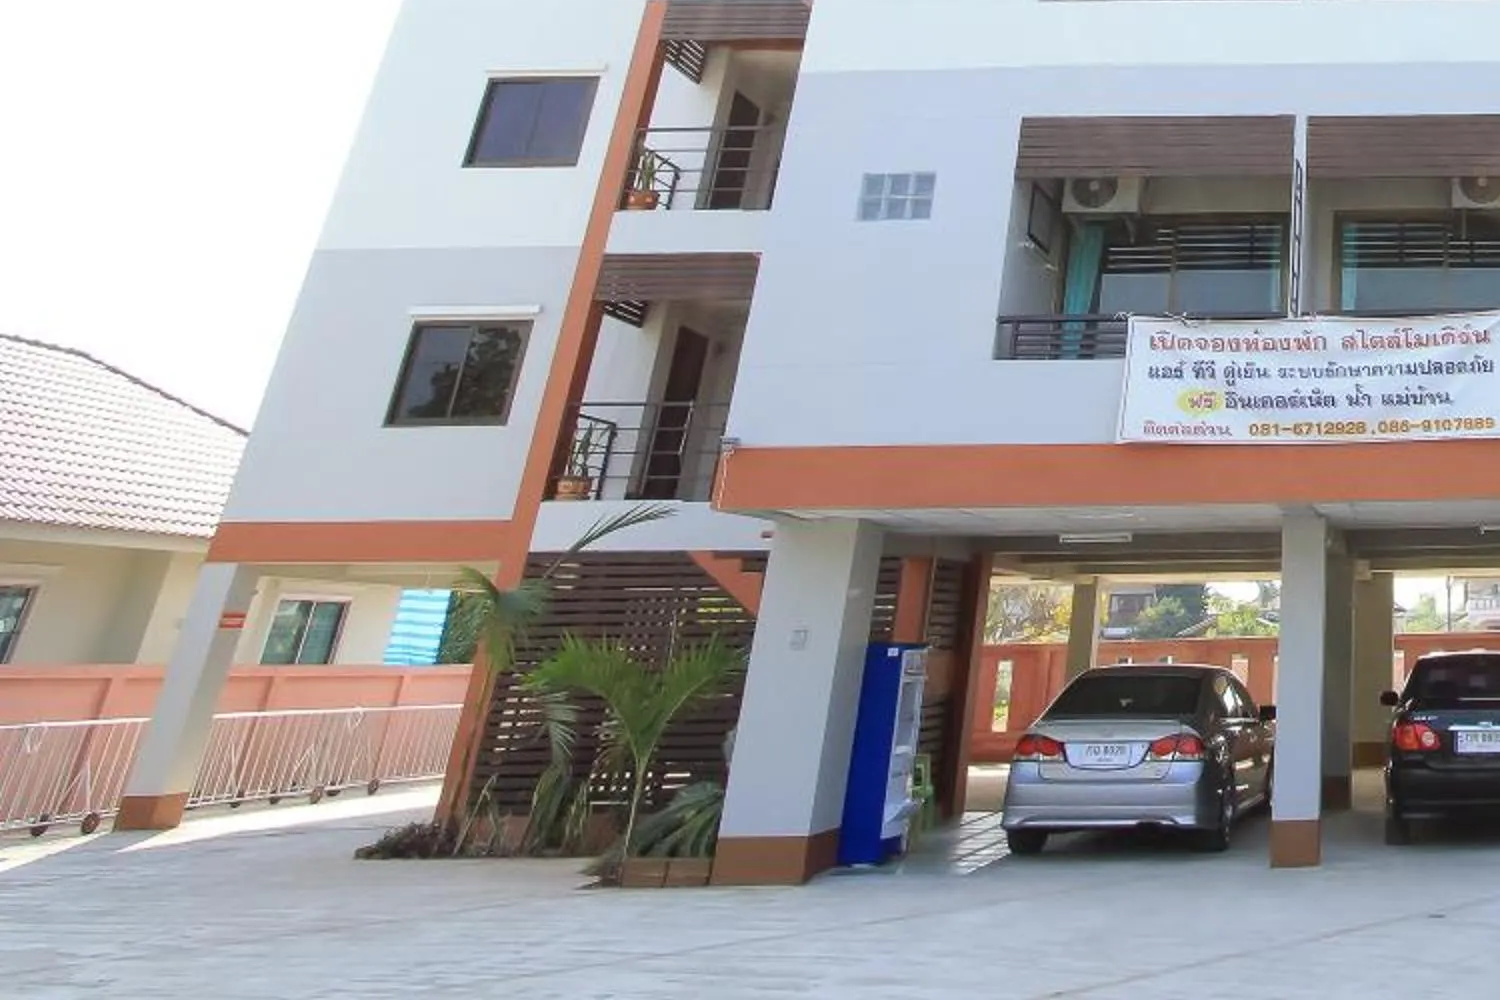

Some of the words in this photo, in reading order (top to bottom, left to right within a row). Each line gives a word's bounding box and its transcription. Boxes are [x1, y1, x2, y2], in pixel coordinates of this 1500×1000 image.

[1148, 360, 1185, 379] แอร์
[1191, 359, 1216, 380] ทีวี
[1187, 390, 1217, 410] ฟรี
[1345, 383, 1372, 408] น้ำ
[1381, 385, 1454, 407] แม่บ้าน
